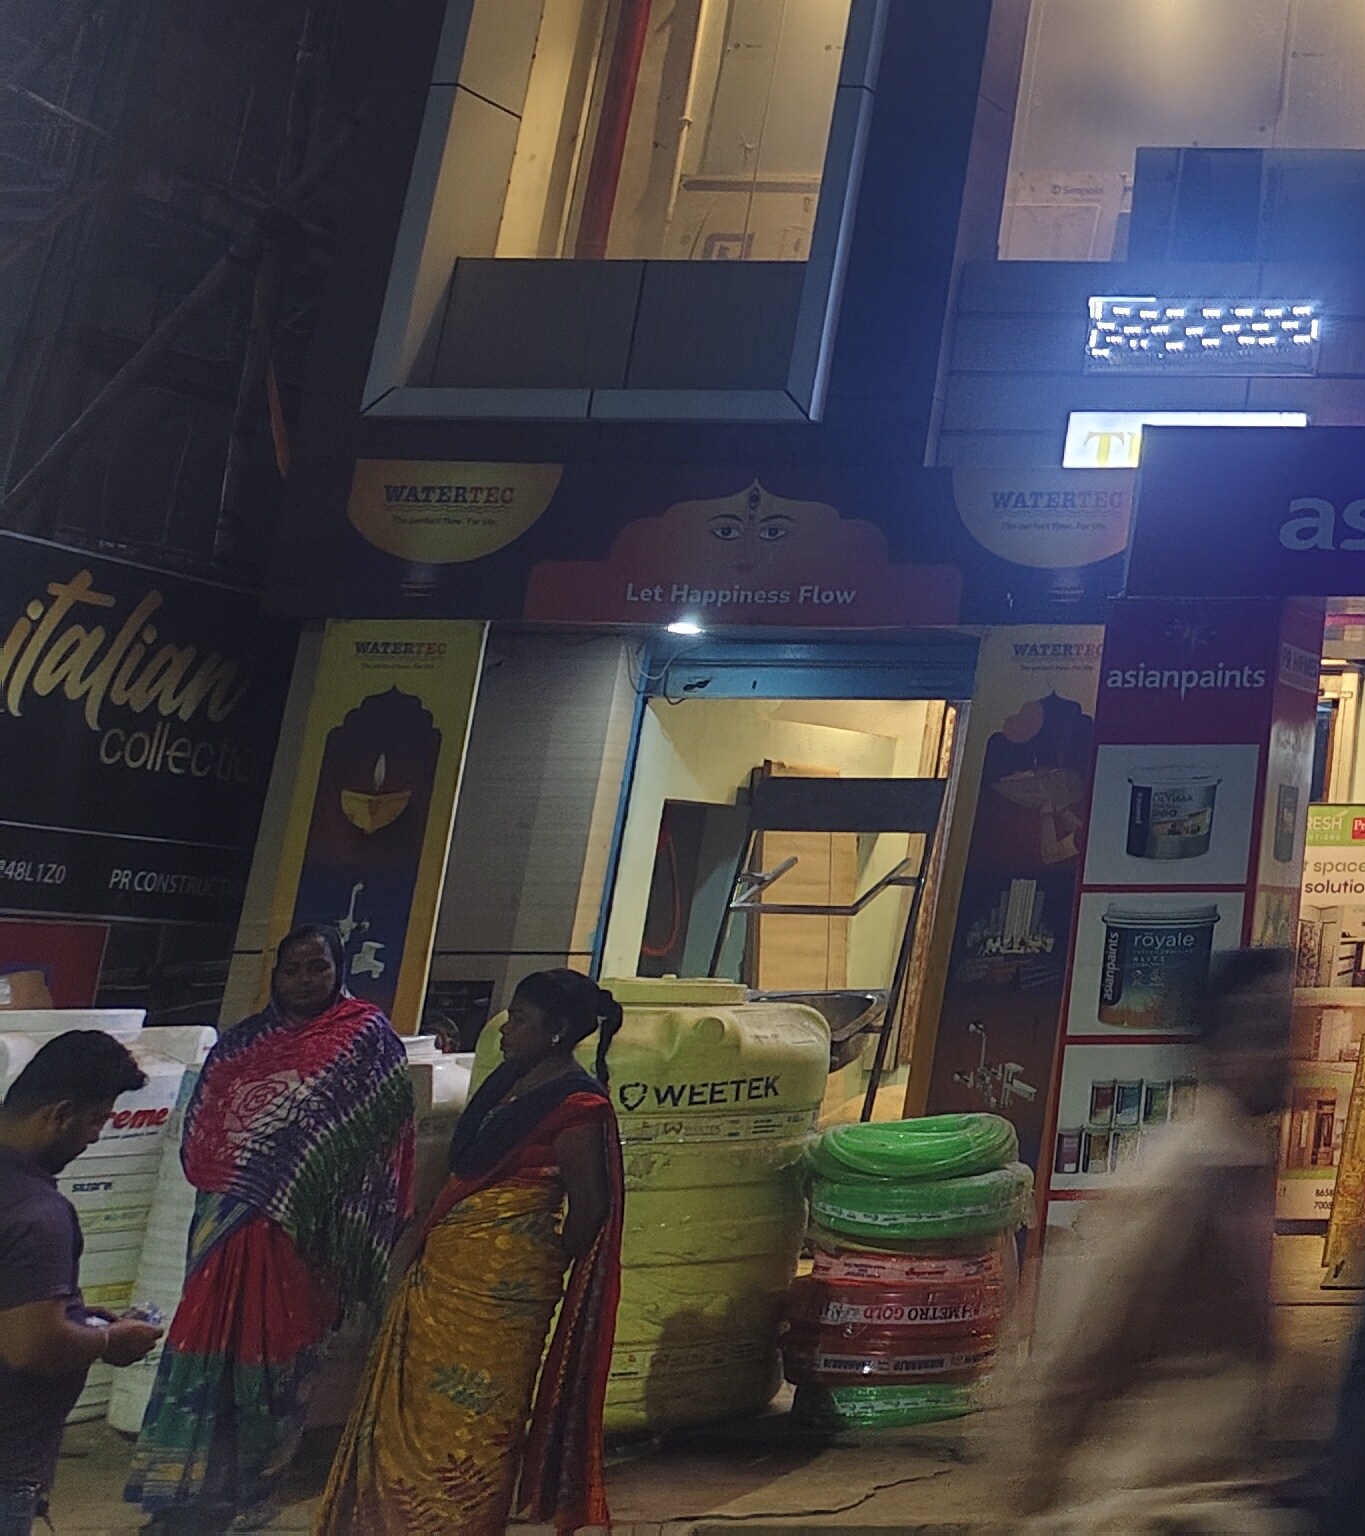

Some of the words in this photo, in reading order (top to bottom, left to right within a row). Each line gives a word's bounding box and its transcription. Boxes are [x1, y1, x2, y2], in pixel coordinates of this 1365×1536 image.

[384, 485, 515, 504] WATERTEC
[991, 490, 1125, 510] WATERTEC
[625, 582, 663, 602] Let
[670, 583, 792, 605] Happiness
[798, 584, 857, 604] Flow
[1106, 663, 1267, 700] asianpaints
[108, 868, 130, 889] PR
[1103, 931, 1119, 1001] asianpaints
[654, 1075, 783, 1107] WEETEK
